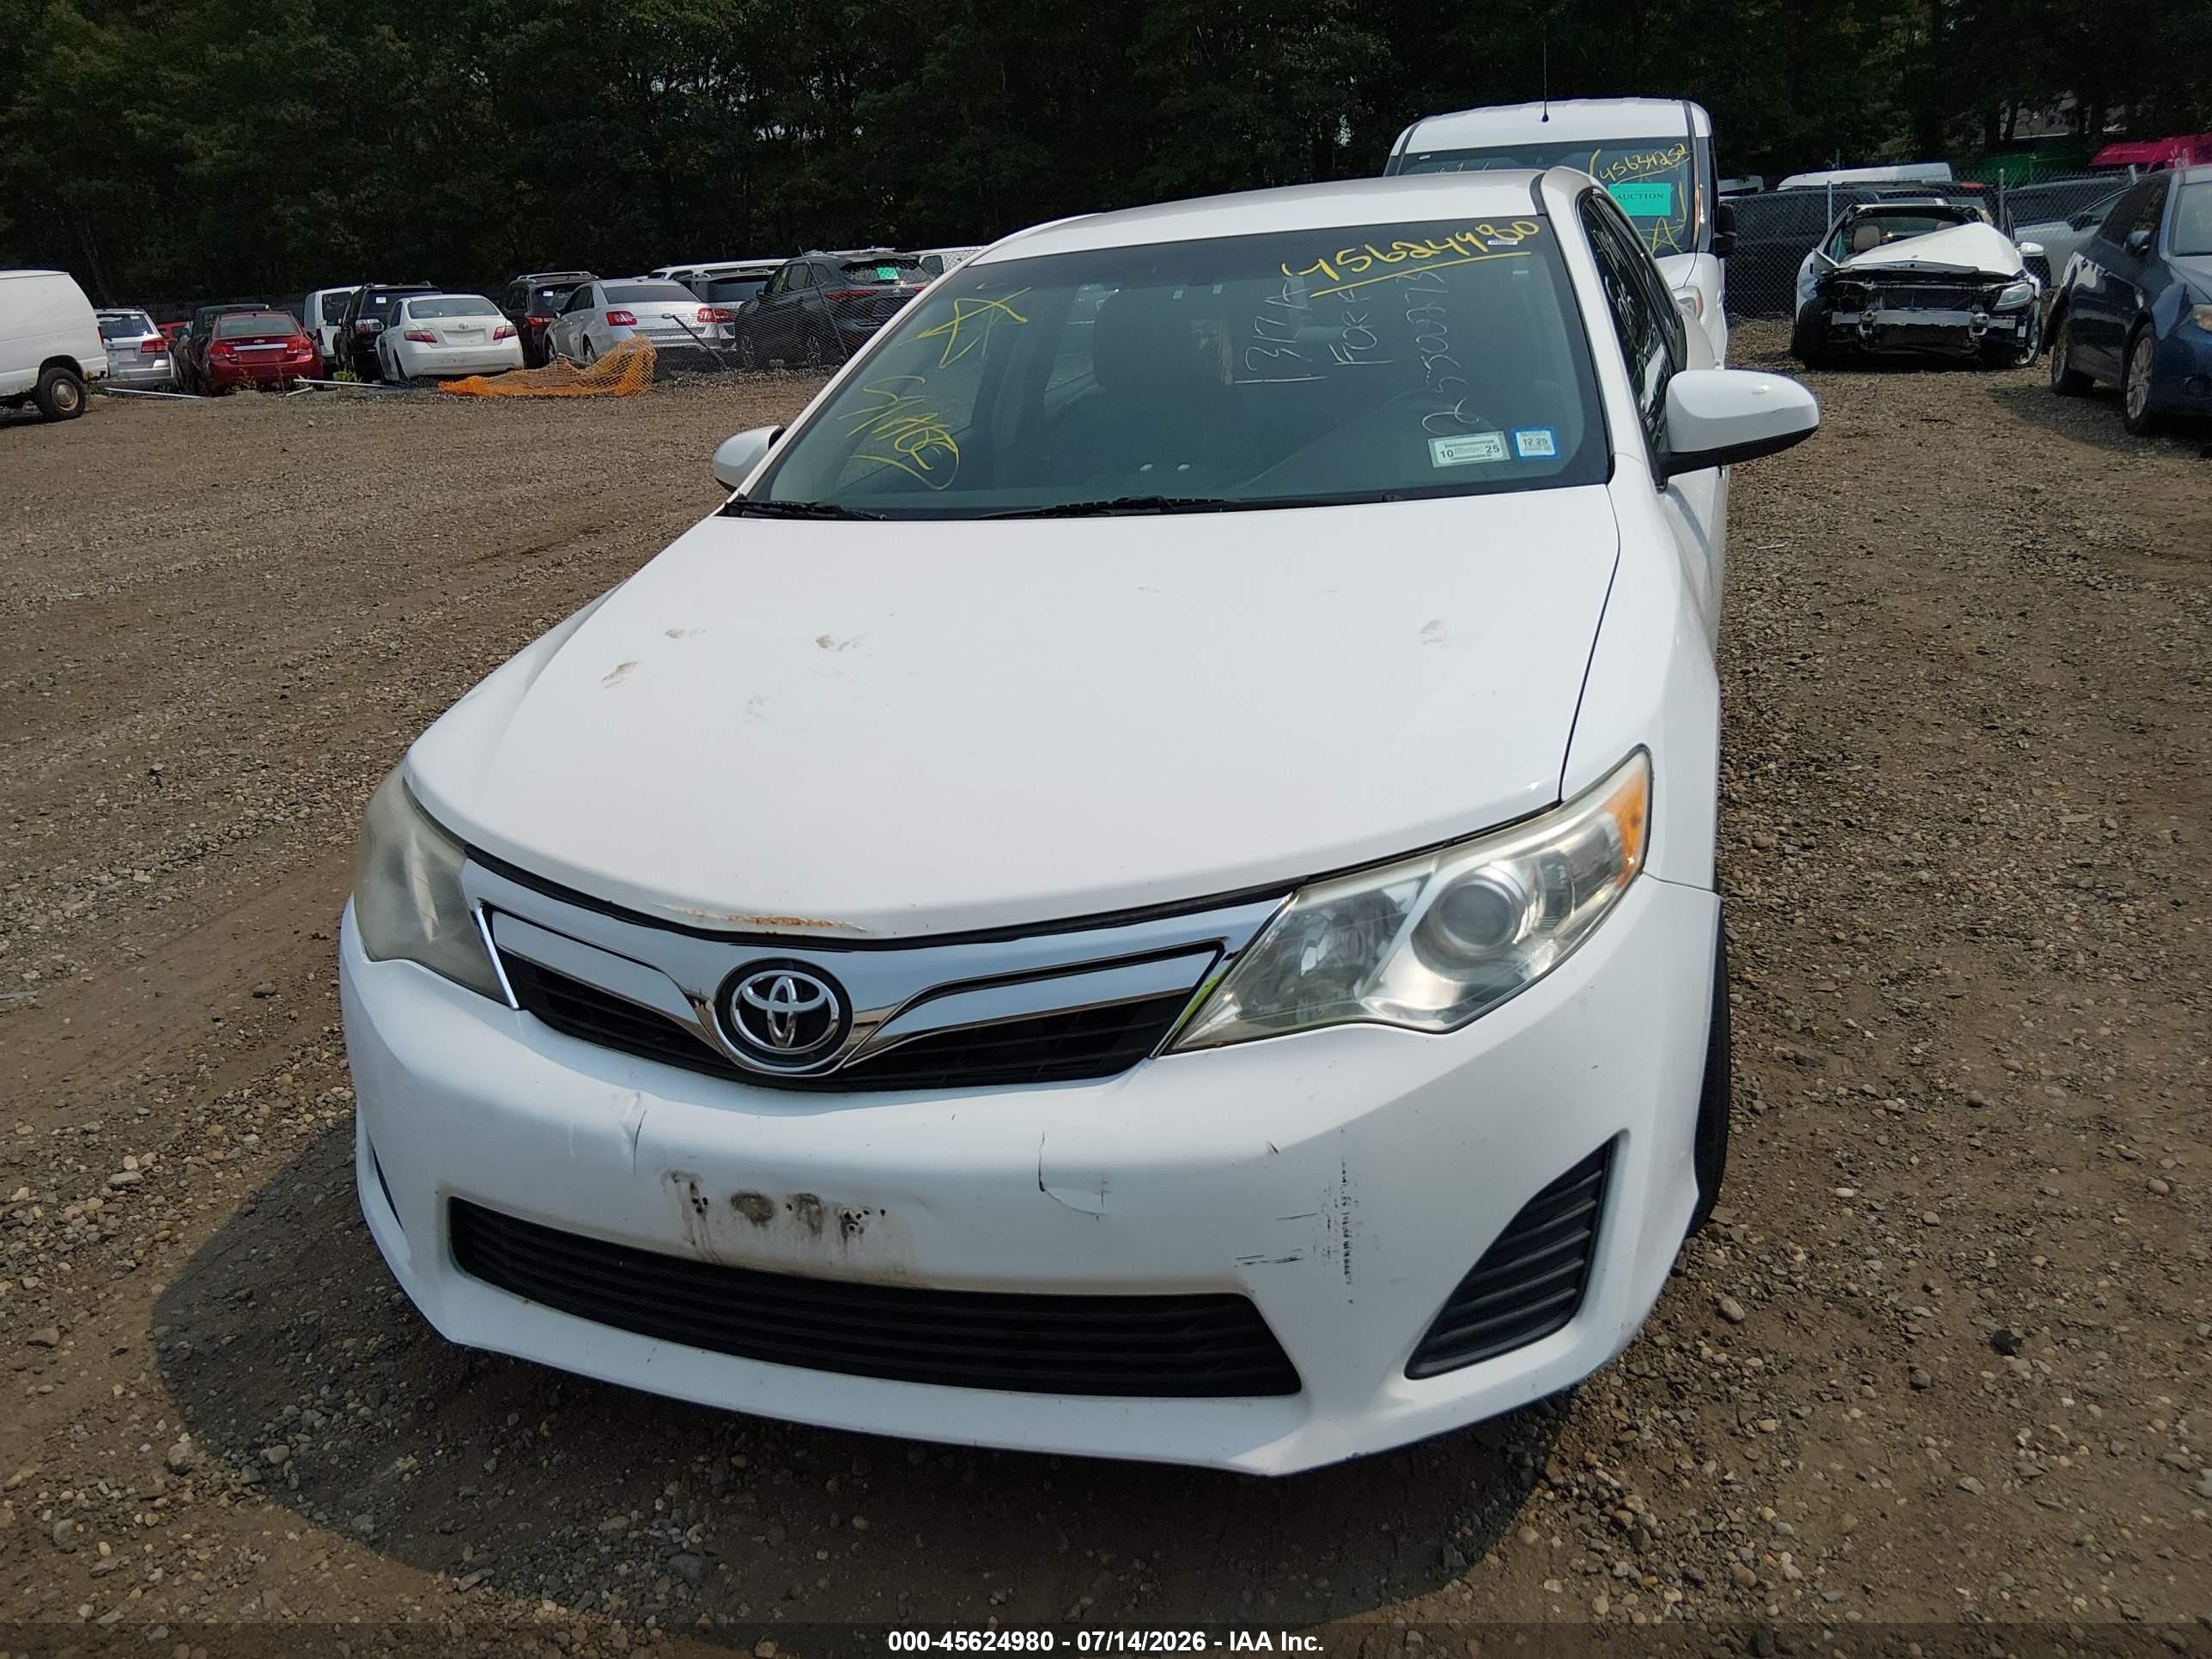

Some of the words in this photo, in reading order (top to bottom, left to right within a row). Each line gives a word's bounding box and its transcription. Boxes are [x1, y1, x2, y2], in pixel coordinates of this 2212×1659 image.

[1280, 220, 1540, 283] 45624980
[1439, 449, 1455, 459] 10
[1485, 445, 1500, 453] 25
